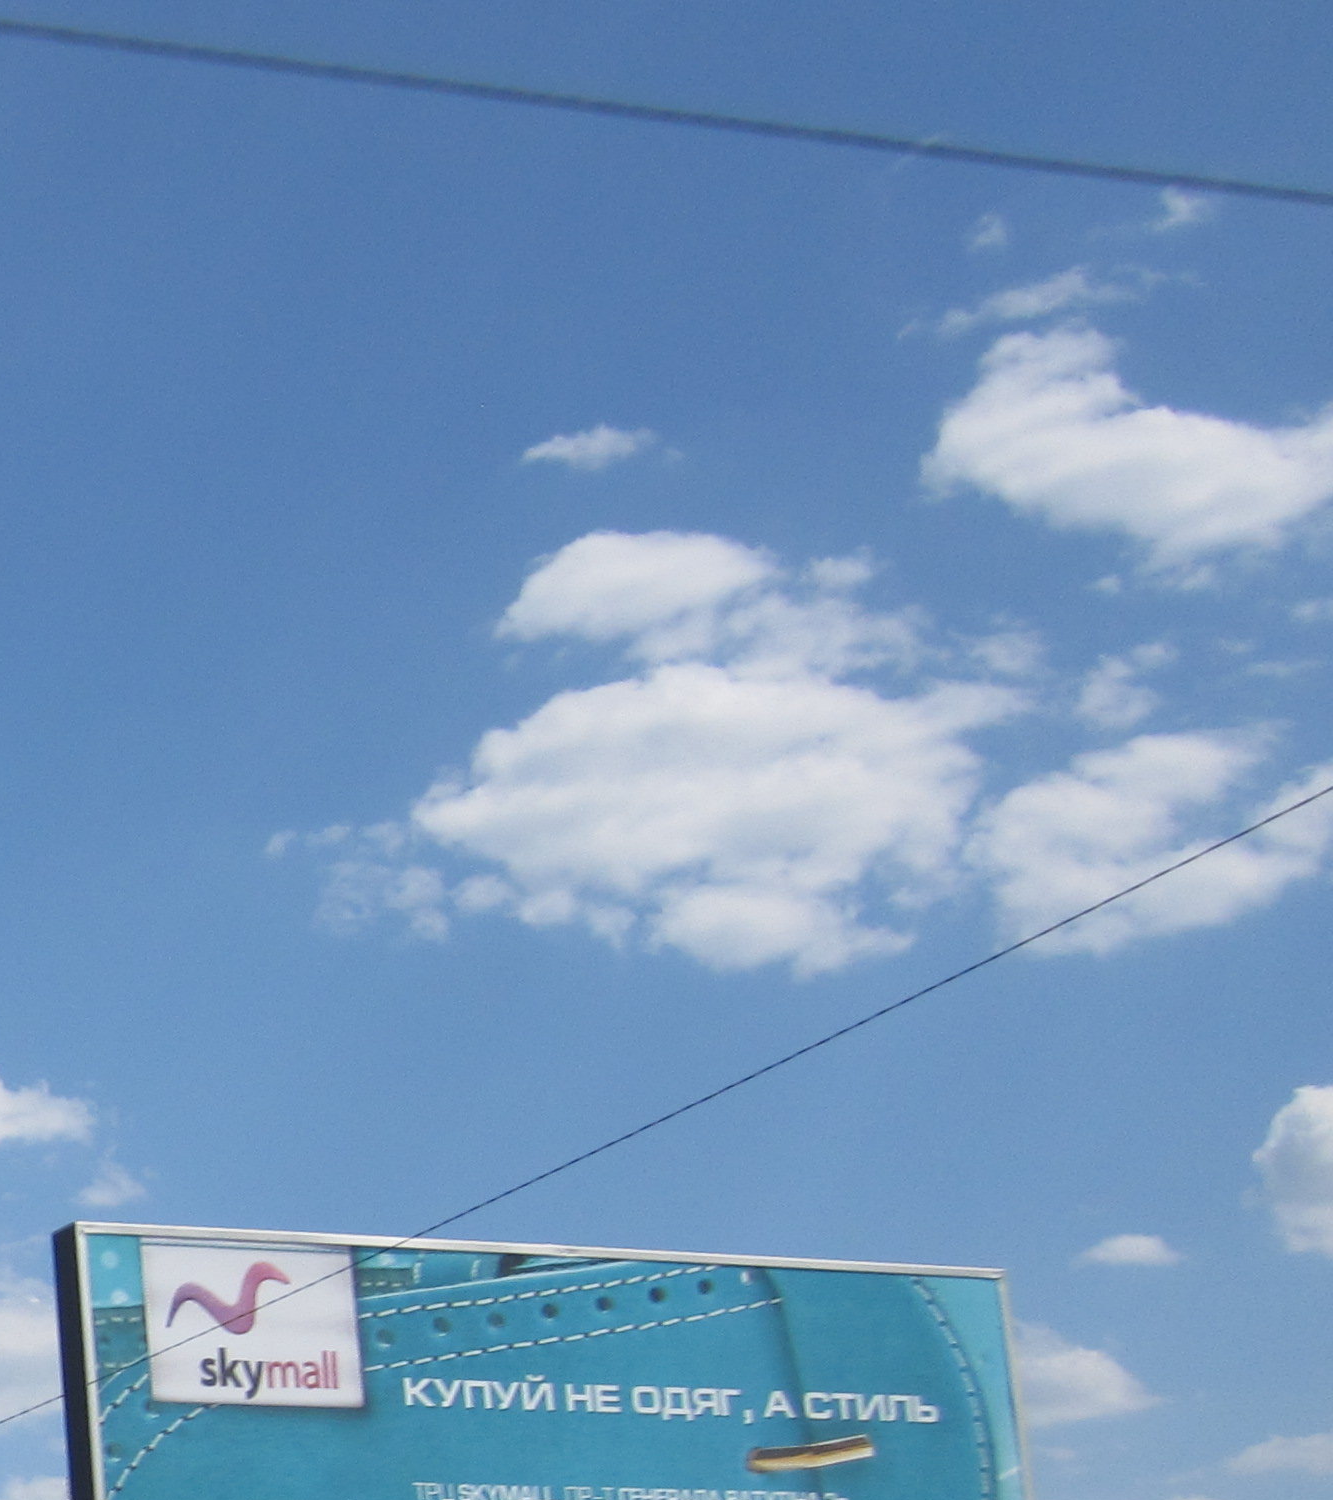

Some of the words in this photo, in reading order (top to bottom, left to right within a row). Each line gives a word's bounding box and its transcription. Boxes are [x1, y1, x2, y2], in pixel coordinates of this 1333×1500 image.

[198, 1347, 339, 1399] skymall
[401, 1374, 556, 1412] КУПУЙ
[564, 1383, 622, 1413] НЕ
[763, 1390, 797, 1420] А
[803, 1391, 940, 1423] СТИЛЬ
